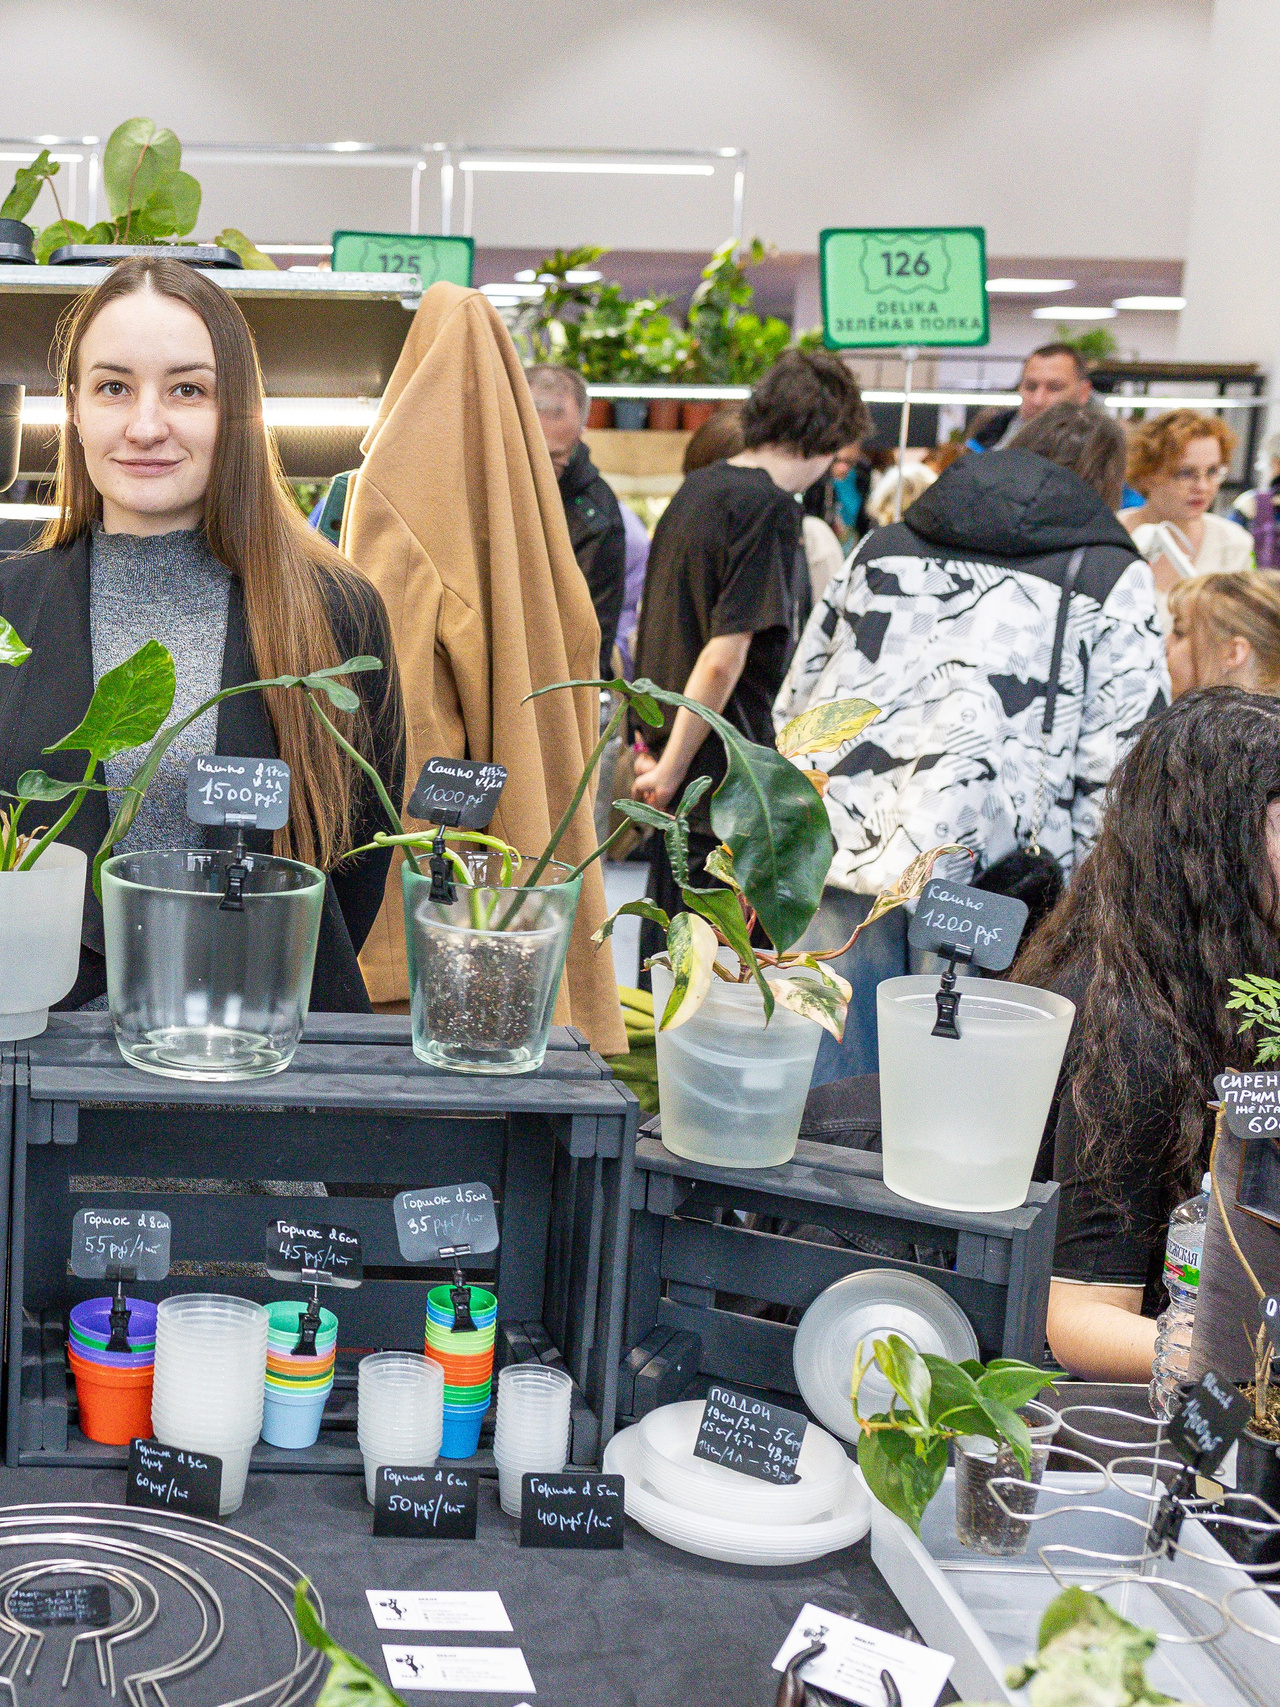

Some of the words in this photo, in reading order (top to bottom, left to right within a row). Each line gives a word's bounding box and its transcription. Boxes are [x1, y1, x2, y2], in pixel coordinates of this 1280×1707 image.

[378, 254, 420, 273] 125
[881, 250, 930, 277] 126
[876, 301, 938, 315] DELIKA
[835, 315, 914, 332] ЗЕЛЁНАЯ
[920, 316, 981, 331] ПОЛКА
[927, 883, 985, 911] Кашпо
[1224, 1089, 1280, 1104] ПРИМ
[1248, 1116, 1280, 1133] 60
[402, 1193, 452, 1212] Горшок
[83, 1211, 131, 1230] Горшок
[276, 1220, 323, 1239] Горшок
[711, 1388, 771, 1421] ПОДДОН
